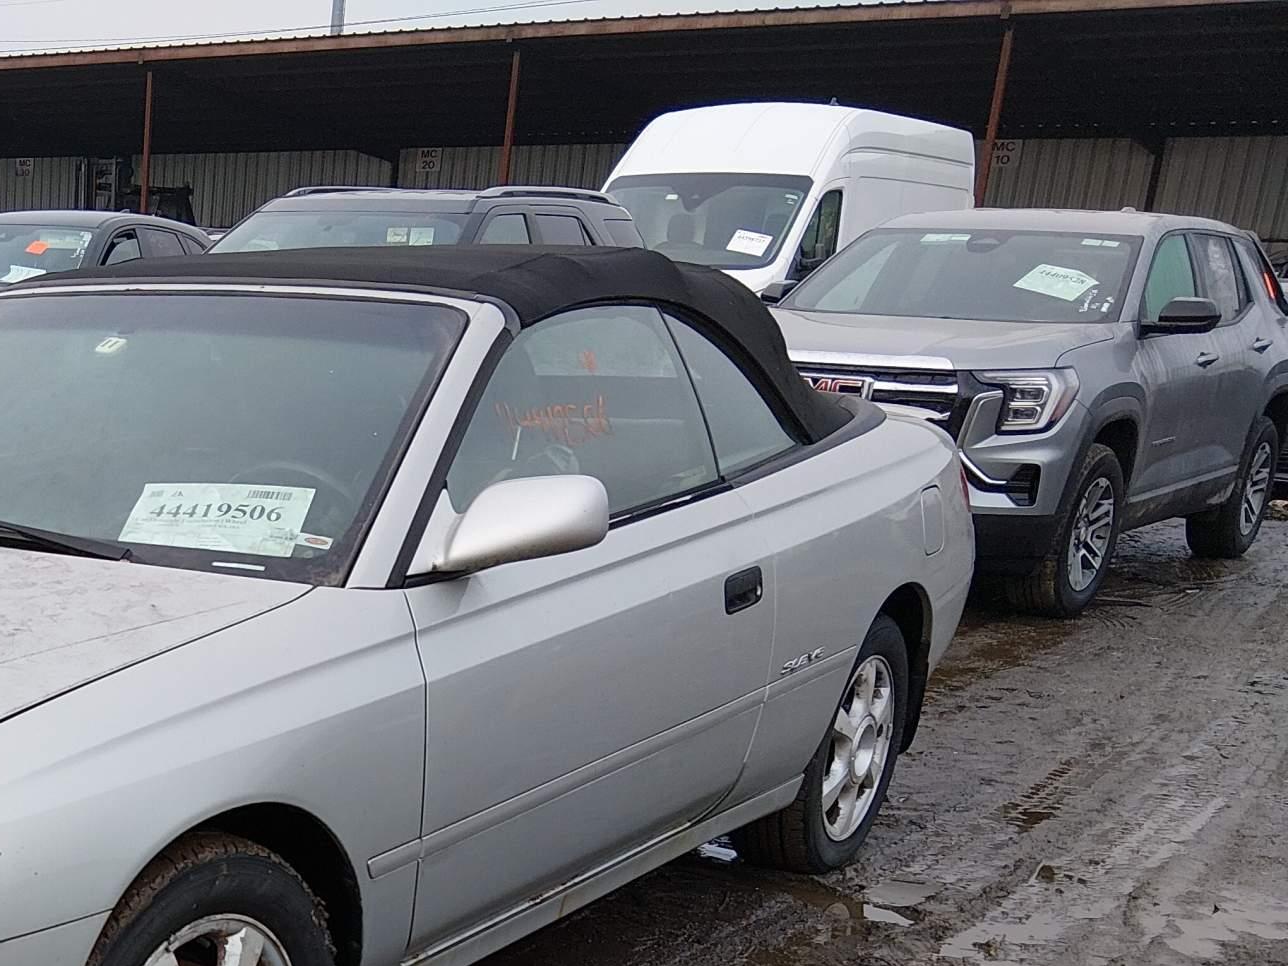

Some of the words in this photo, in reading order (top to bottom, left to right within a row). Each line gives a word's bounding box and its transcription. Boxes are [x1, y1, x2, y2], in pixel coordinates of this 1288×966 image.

[993, 141, 1016, 152] MC
[421, 149, 439, 159] MC
[994, 154, 1010, 165] 10
[421, 160, 436, 170] 20
[149, 502, 286, 522] 44419506
